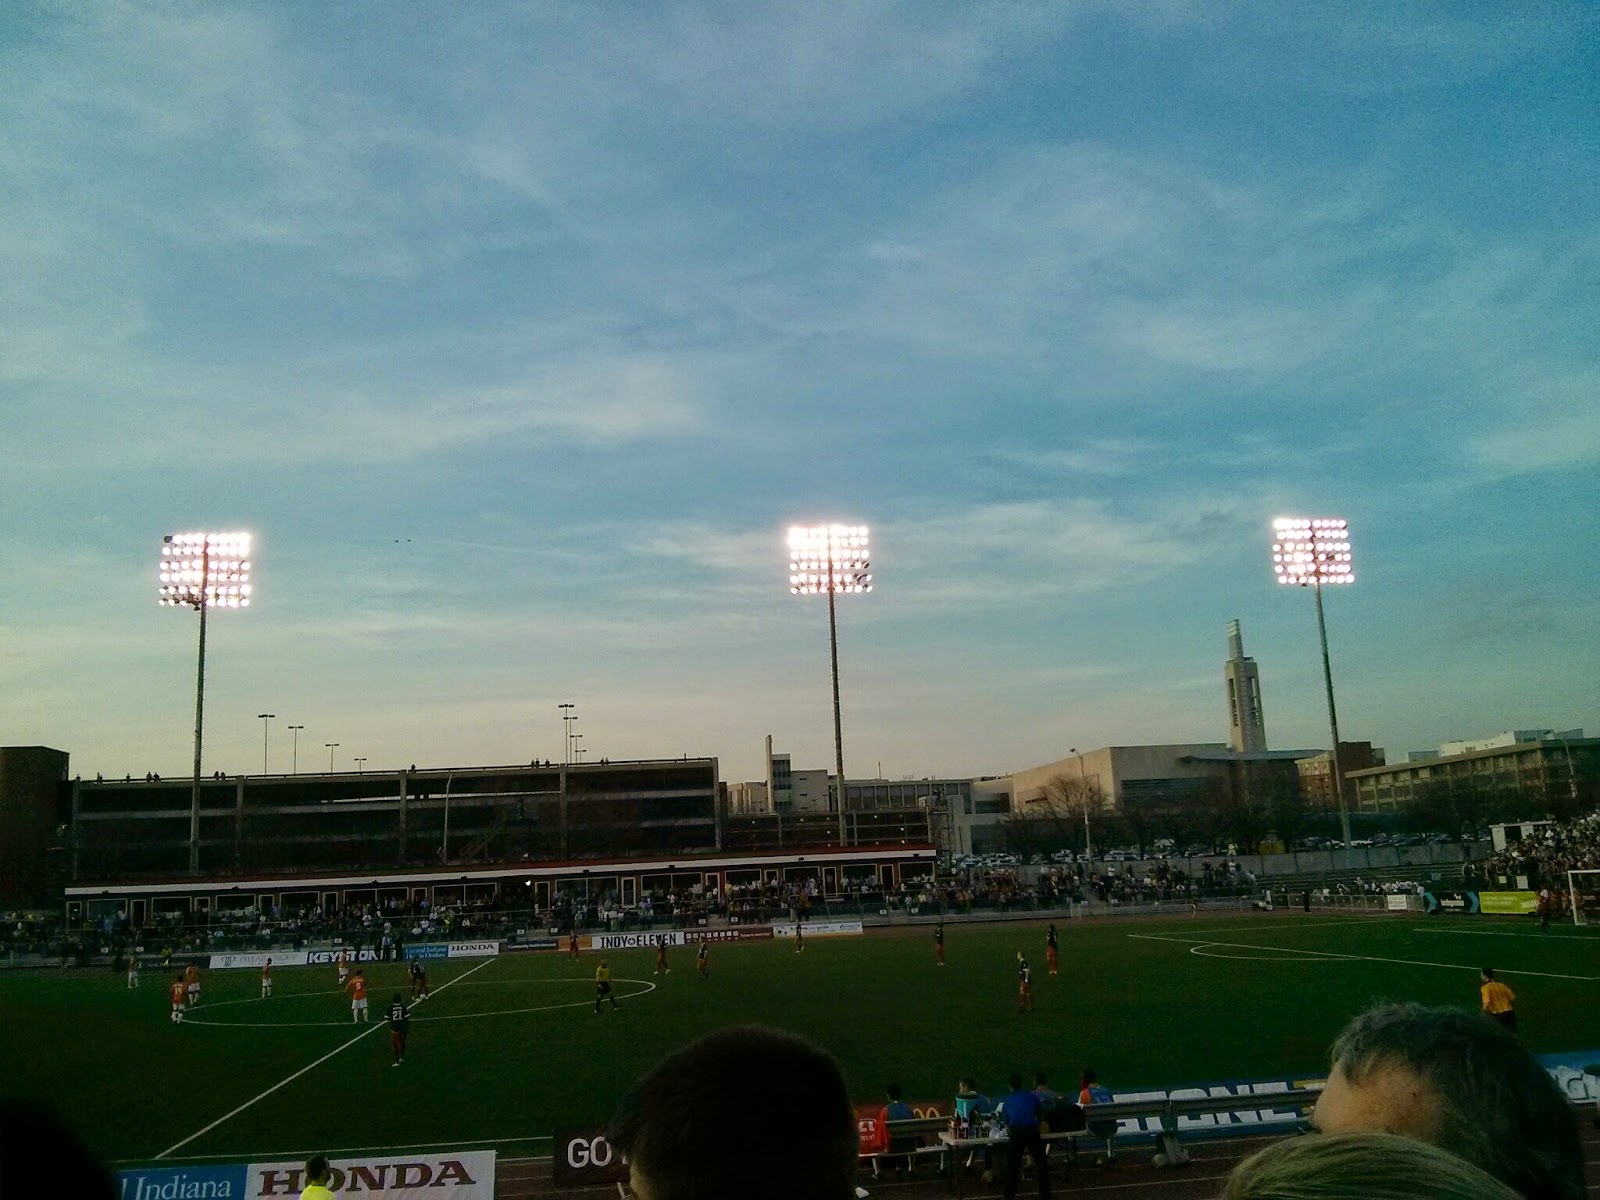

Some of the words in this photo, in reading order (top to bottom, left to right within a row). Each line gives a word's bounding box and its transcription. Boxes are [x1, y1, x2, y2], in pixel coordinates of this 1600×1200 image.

[451, 943, 494, 951] HONDA
[600, 935, 628, 948] INDY
[392, 1010, 403, 1021] 21
[135, 1174, 232, 1200] Indiana
